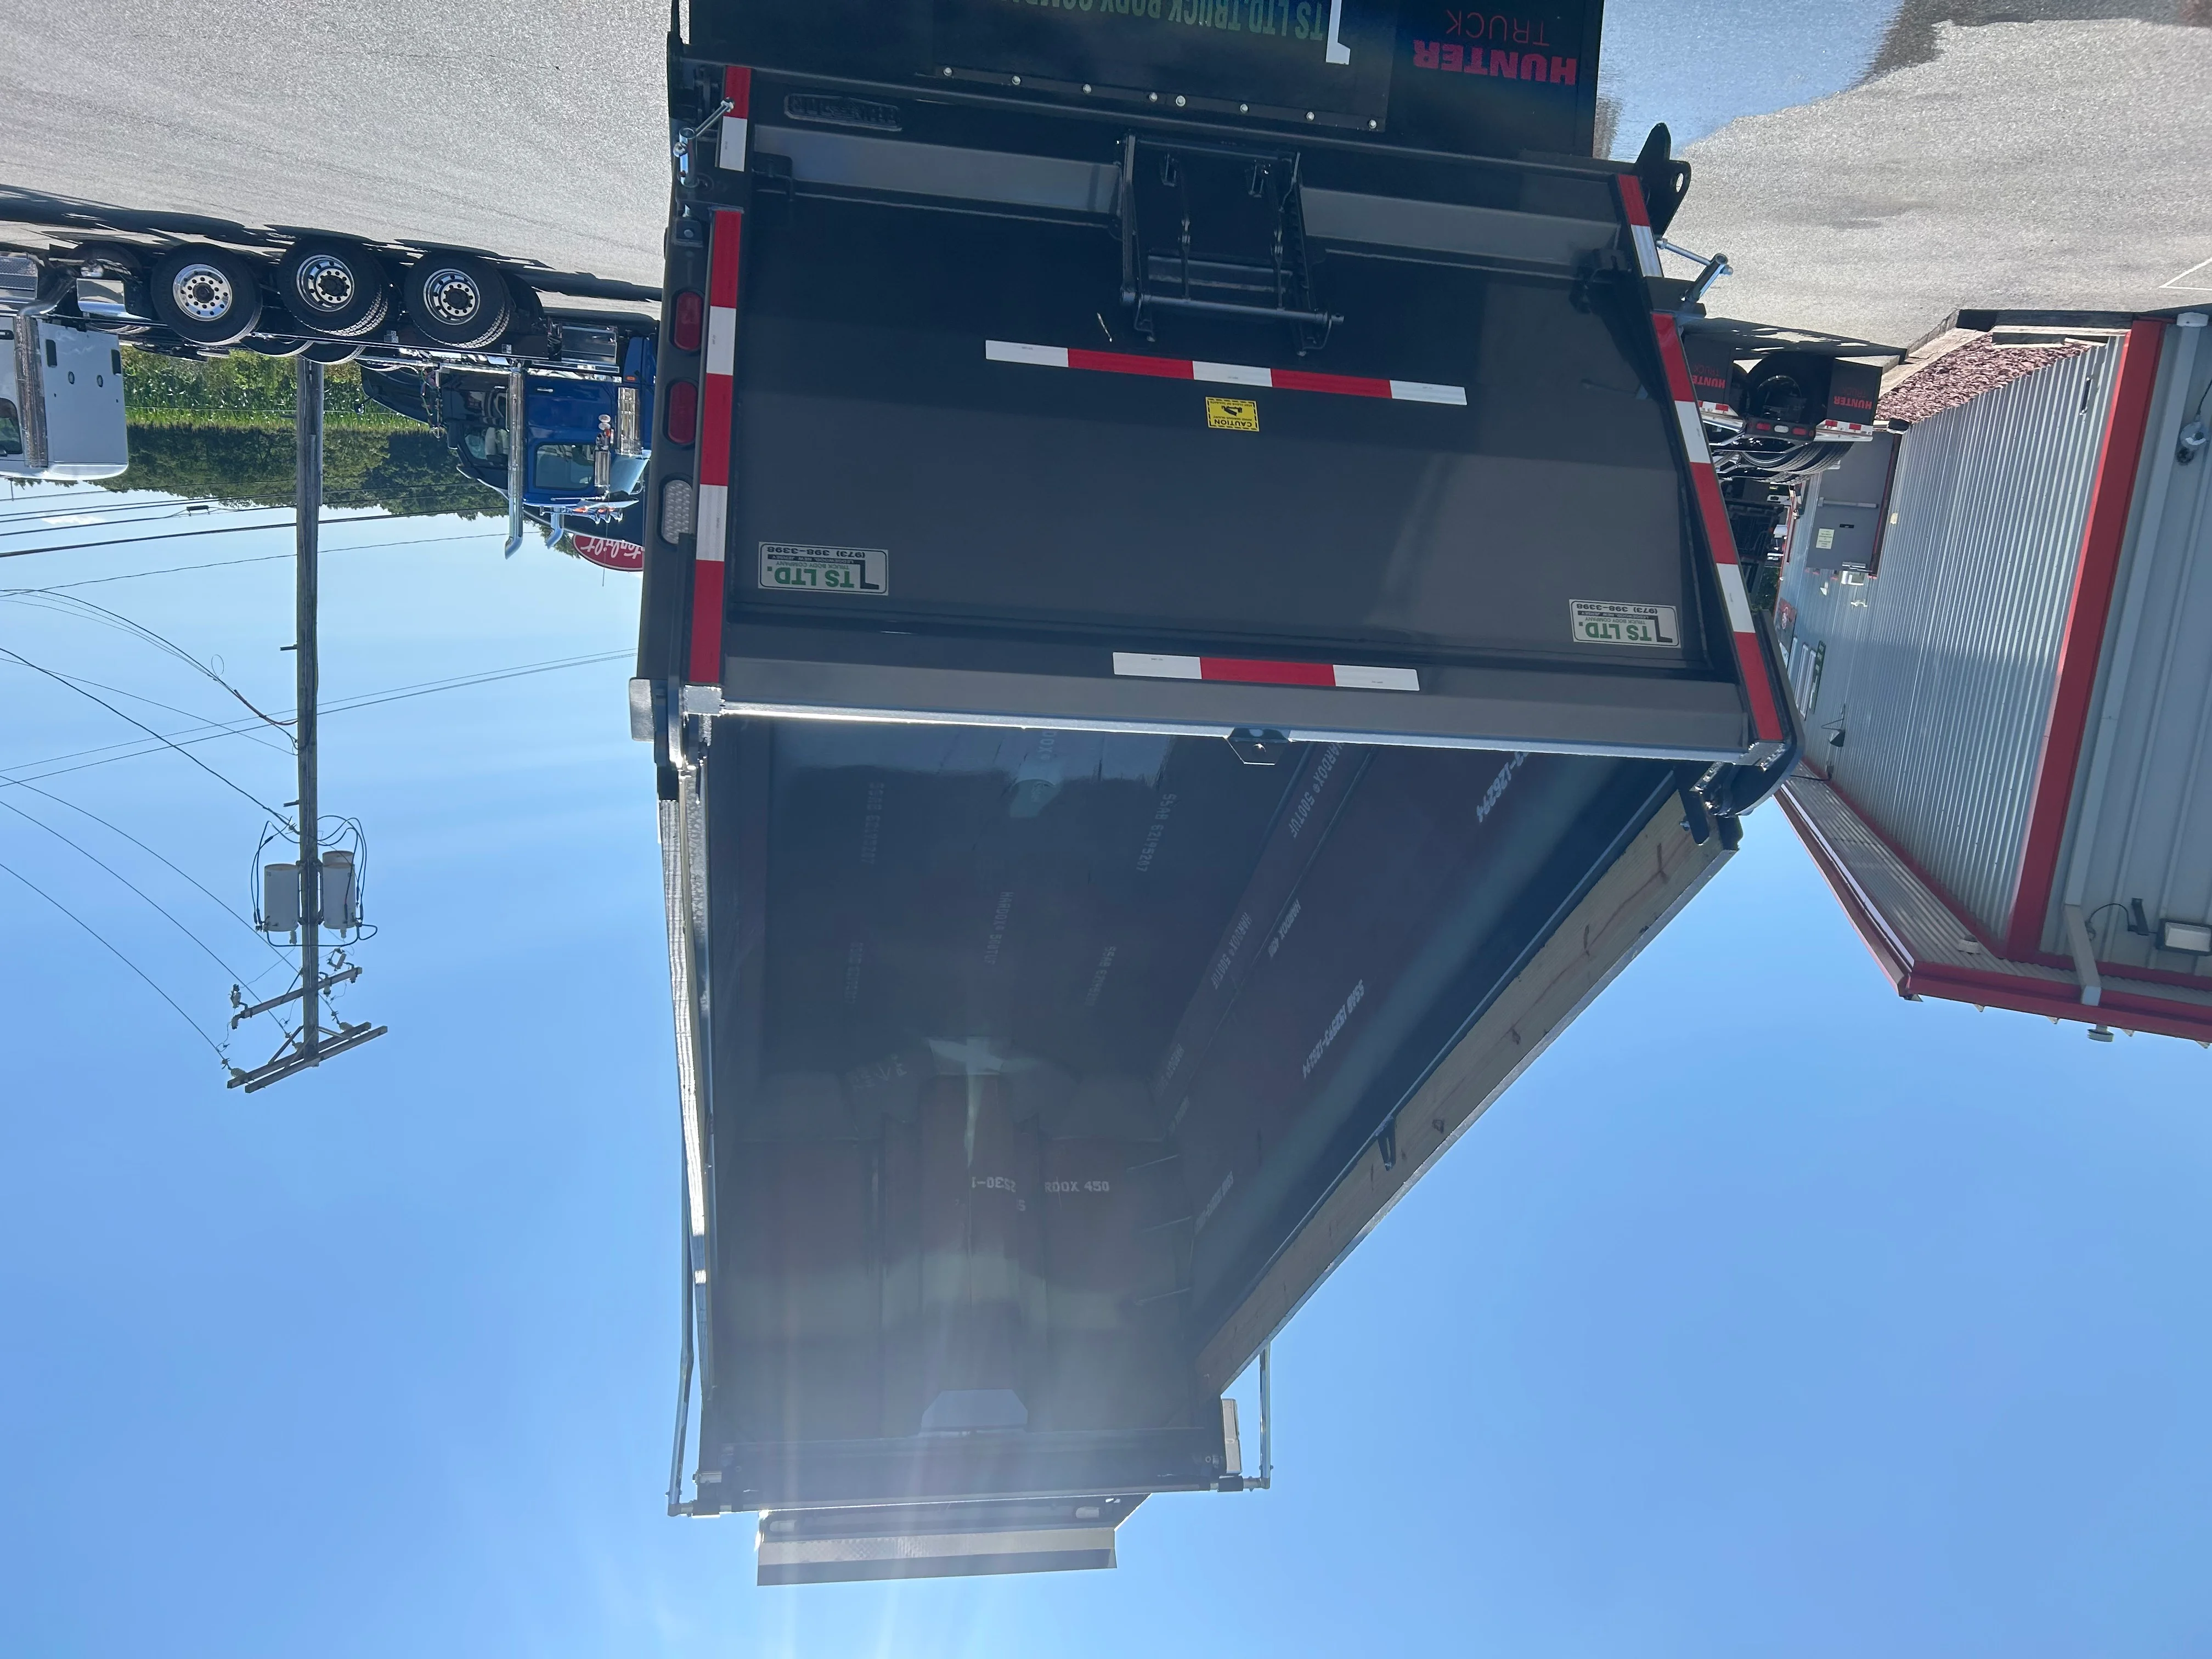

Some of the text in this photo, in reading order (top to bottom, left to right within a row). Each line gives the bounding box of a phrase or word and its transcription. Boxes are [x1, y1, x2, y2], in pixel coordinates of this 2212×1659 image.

[1446, 9, 1550, 47] TRUCK
[1413, 39, 1577, 86] HUNTER
[1692, 374, 1726, 390] HUNTE
[1833, 396, 1872, 410] HUNTER
[1214, 419, 1252, 427] CAUTION
[766, 546, 865, 558] (973) 398-3398
[767, 566, 816, 586] LTD.
[1576, 603, 1628, 612] 398-3398
[1578, 622, 1621, 640] LTD.
[1288, 791, 1316, 840] 500TUF
[1084, 1181, 1109, 1192] 450
